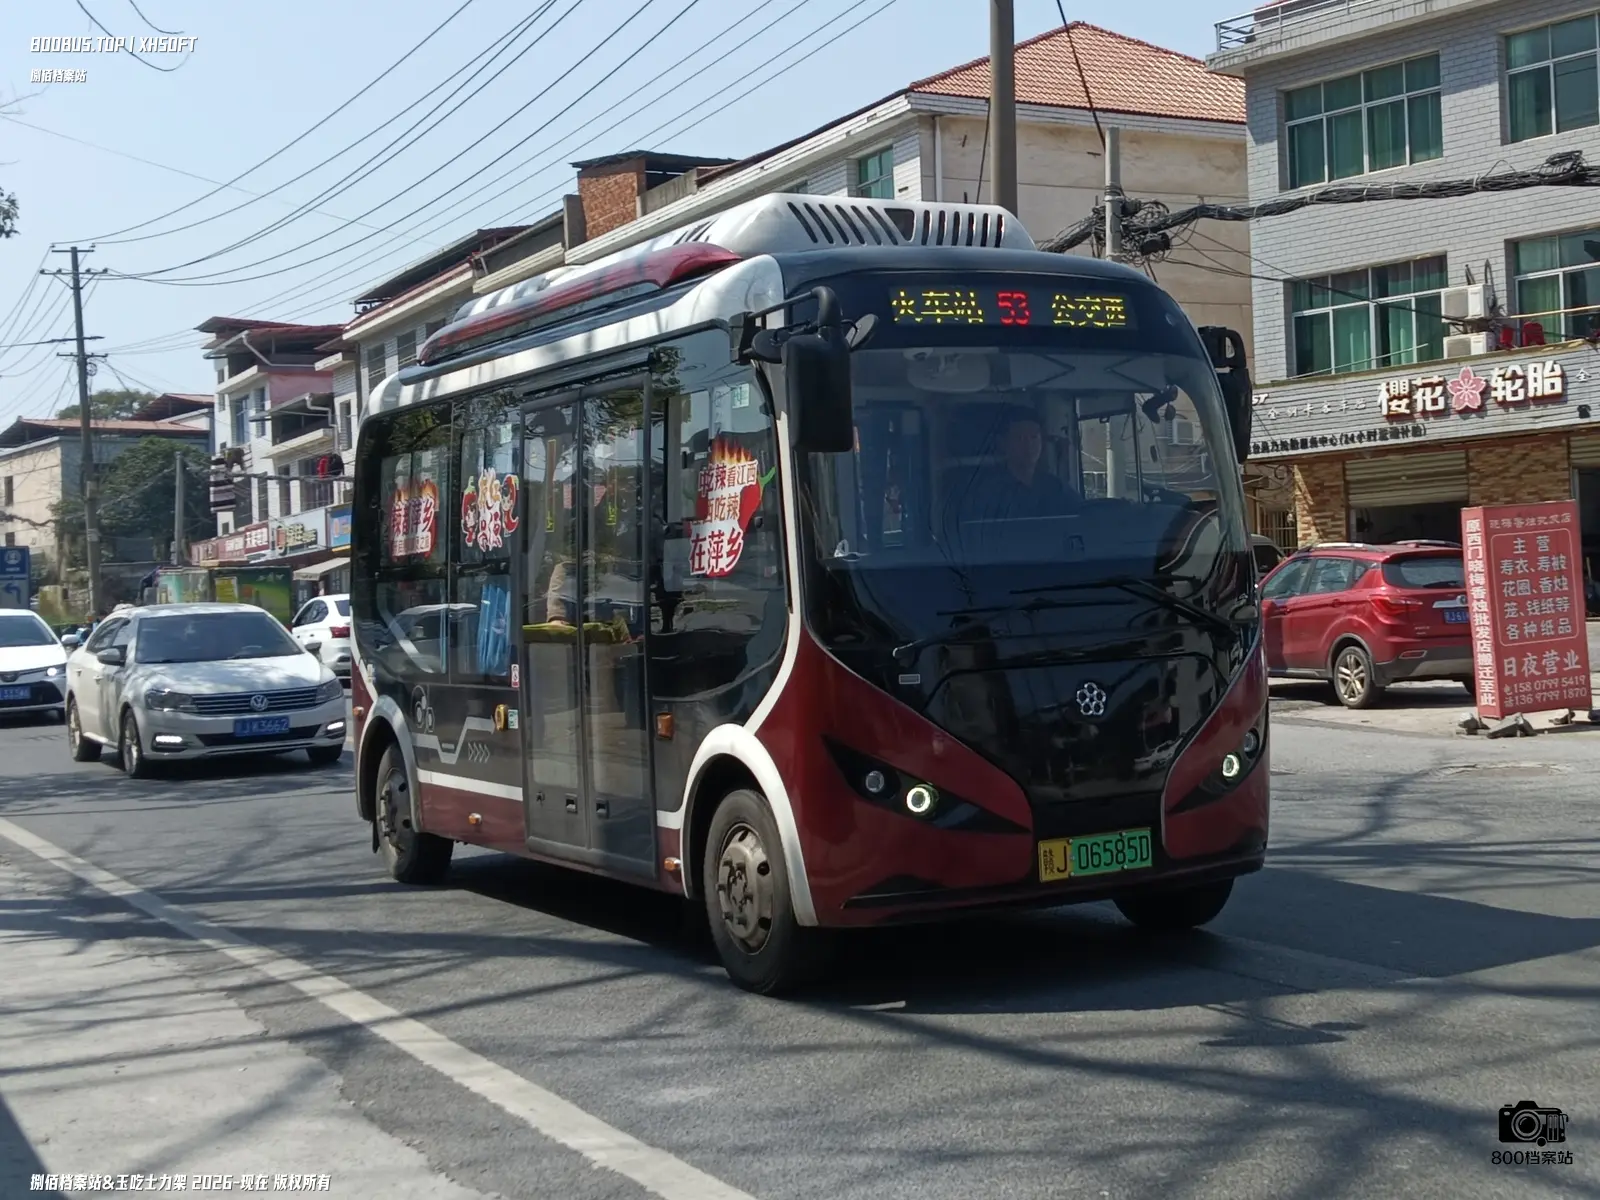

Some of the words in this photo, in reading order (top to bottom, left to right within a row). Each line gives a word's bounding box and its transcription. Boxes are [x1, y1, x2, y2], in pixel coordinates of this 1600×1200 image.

[998, 292, 1030, 325] 53
[1379, 376, 1445, 417] 樱花
[1490, 360, 1564, 402] 轮胎
[689, 528, 742, 573] 在萍乡
[1513, 535, 1550, 554] 主营
[1501, 553, 1567, 575] 寿衣、寿被
[1506, 617, 1572, 640] 各种纸品
[1504, 648, 1582, 678] 日夜营业
[1514, 681, 1532, 693] 158
[1534, 678, 1559, 690] 0799
[1561, 675, 1587, 687] 5419
[1515, 693, 1533, 706] 136
[1535, 691, 1560, 703] 9799
[1563, 687, 1588, 700] 1870
